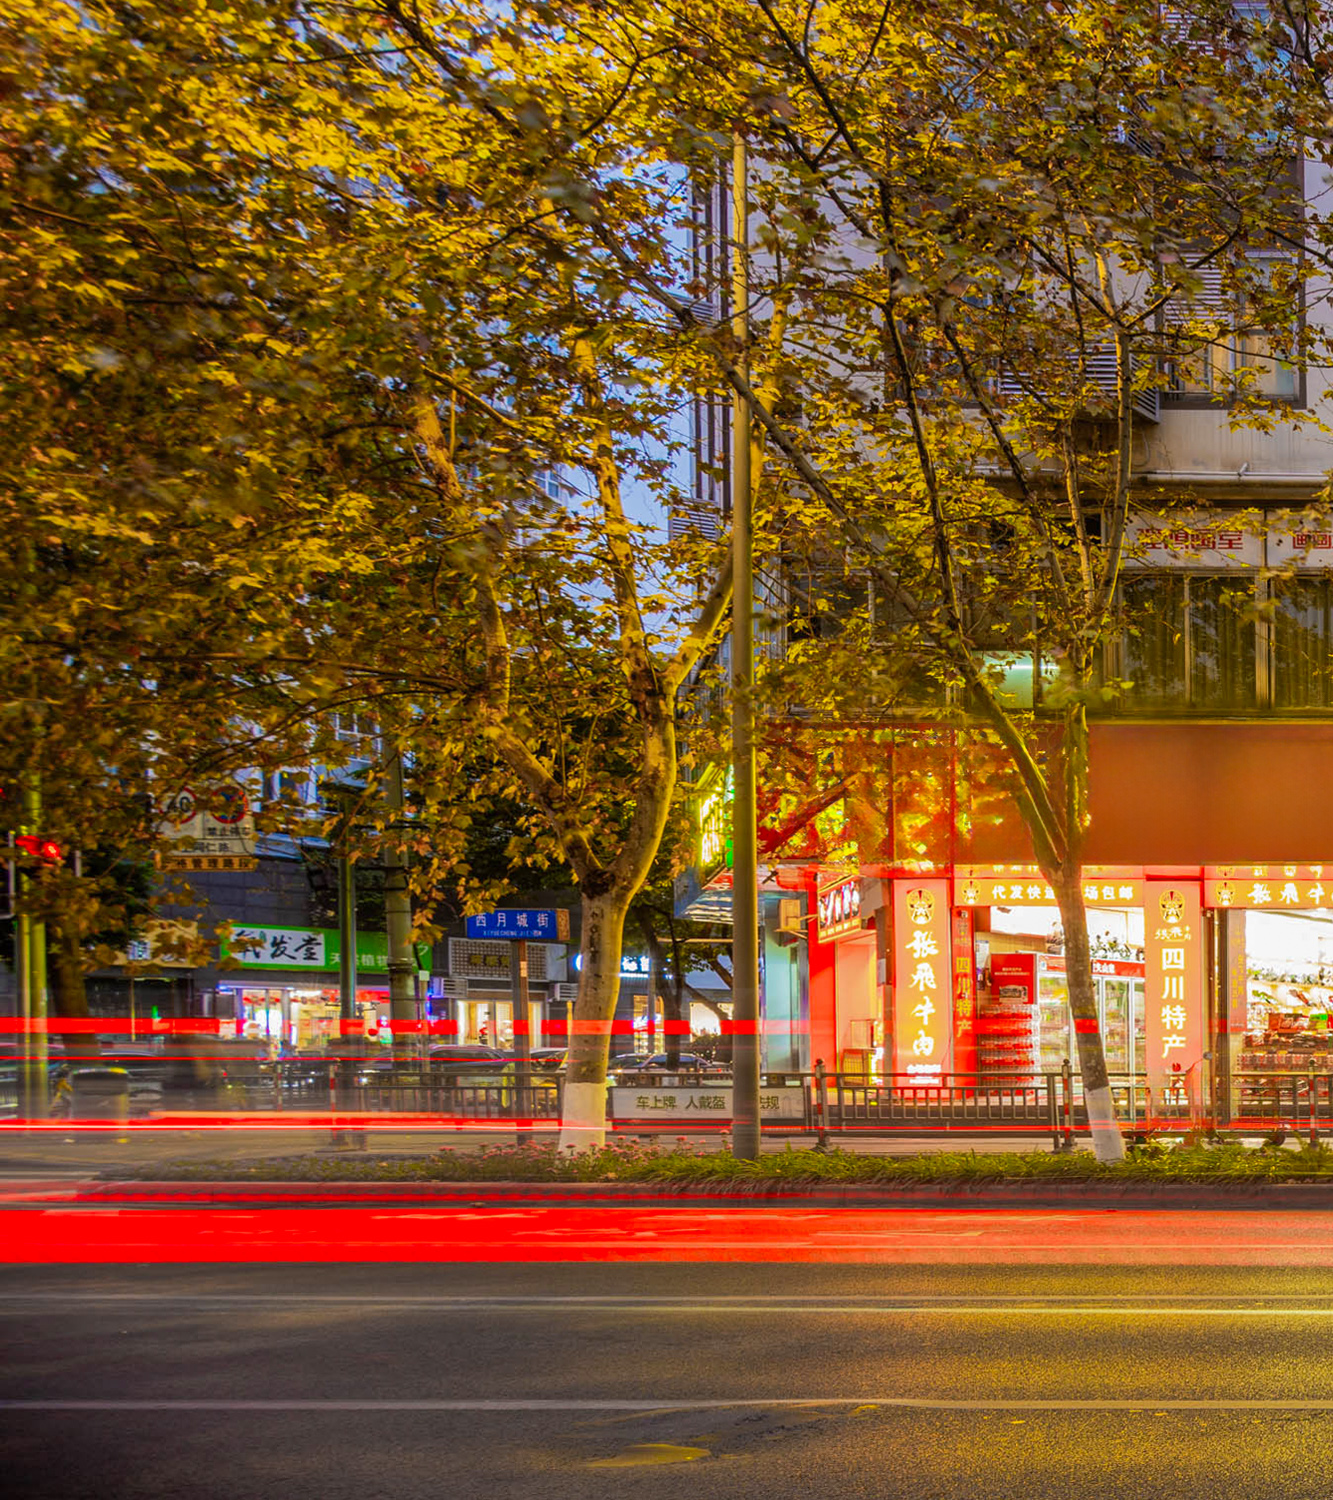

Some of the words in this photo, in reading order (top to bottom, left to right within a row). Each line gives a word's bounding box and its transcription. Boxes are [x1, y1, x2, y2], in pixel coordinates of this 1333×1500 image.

[1082, 885, 1134, 900] 场包邮
[1161, 948, 1187, 1059] 四川特产
[636, 1095, 677, 1110] 车上牌
[685, 1095, 726, 1110] 人戴盔
